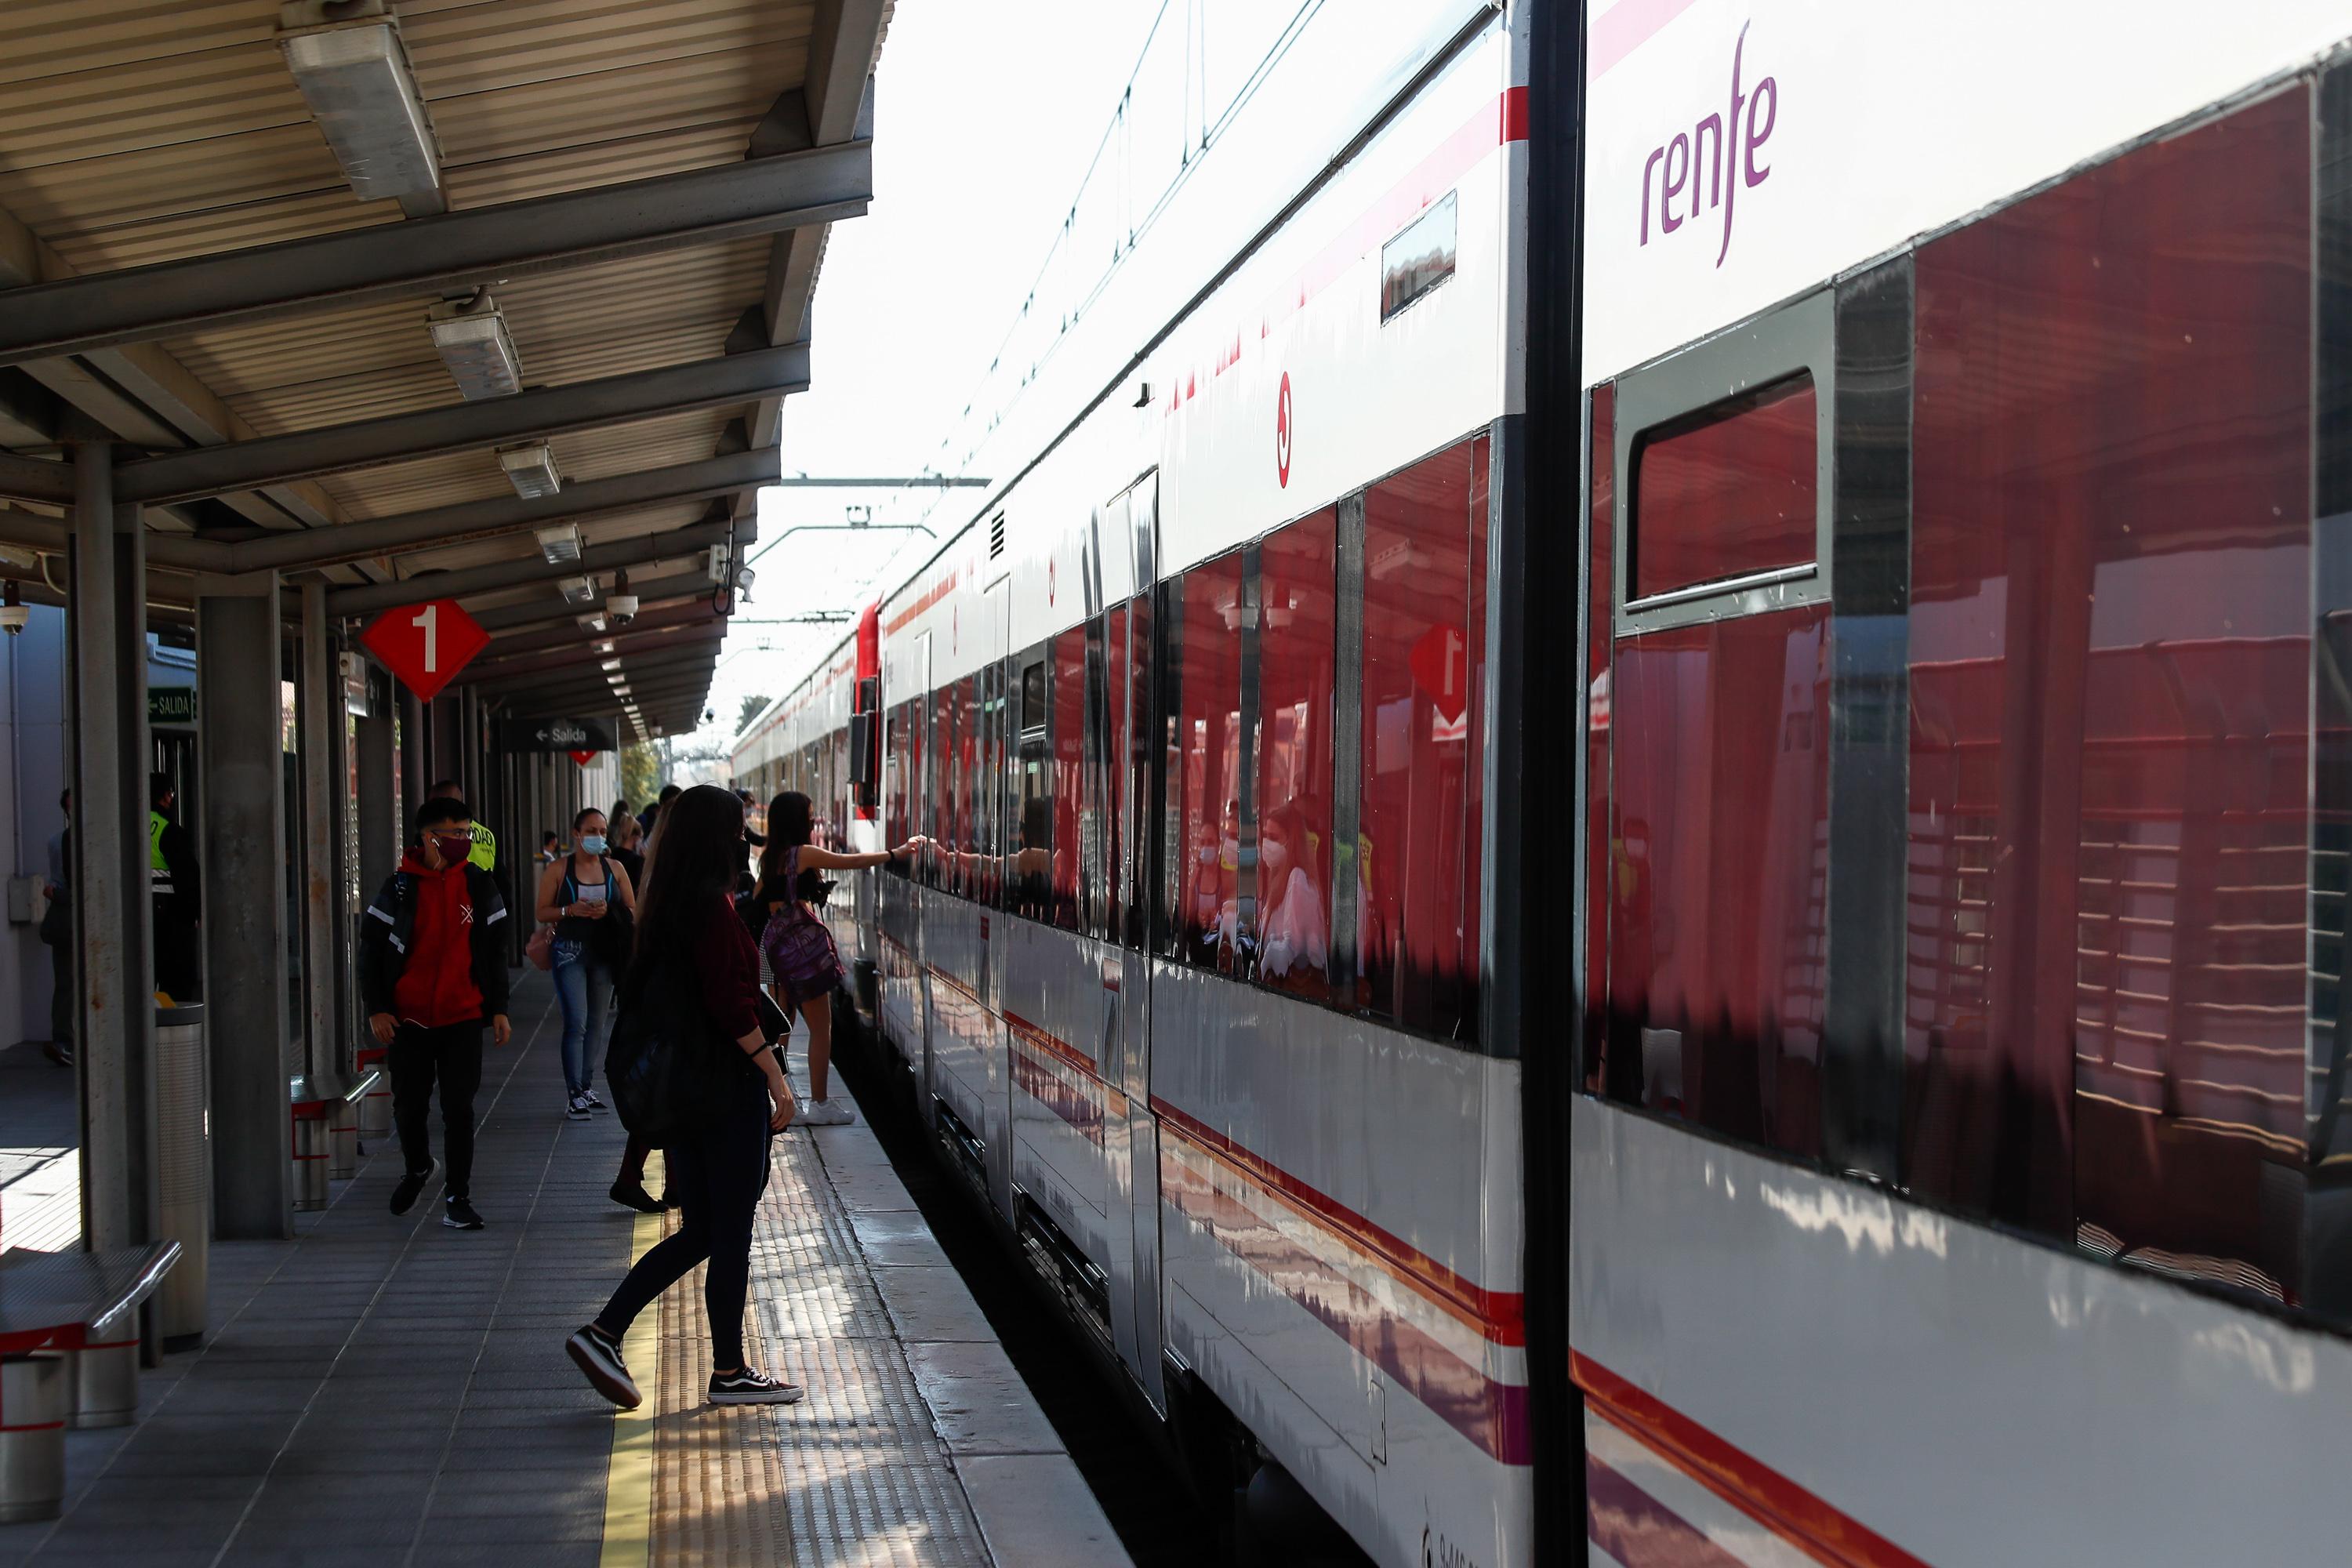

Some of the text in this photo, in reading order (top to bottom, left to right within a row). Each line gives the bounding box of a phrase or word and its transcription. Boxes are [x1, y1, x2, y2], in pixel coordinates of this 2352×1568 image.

[1640, 17, 1777, 269] renfe
[412, 604, 437, 673] 1
[158, 695, 189, 715] SALIDA
[552, 728, 587, 742] Salida
